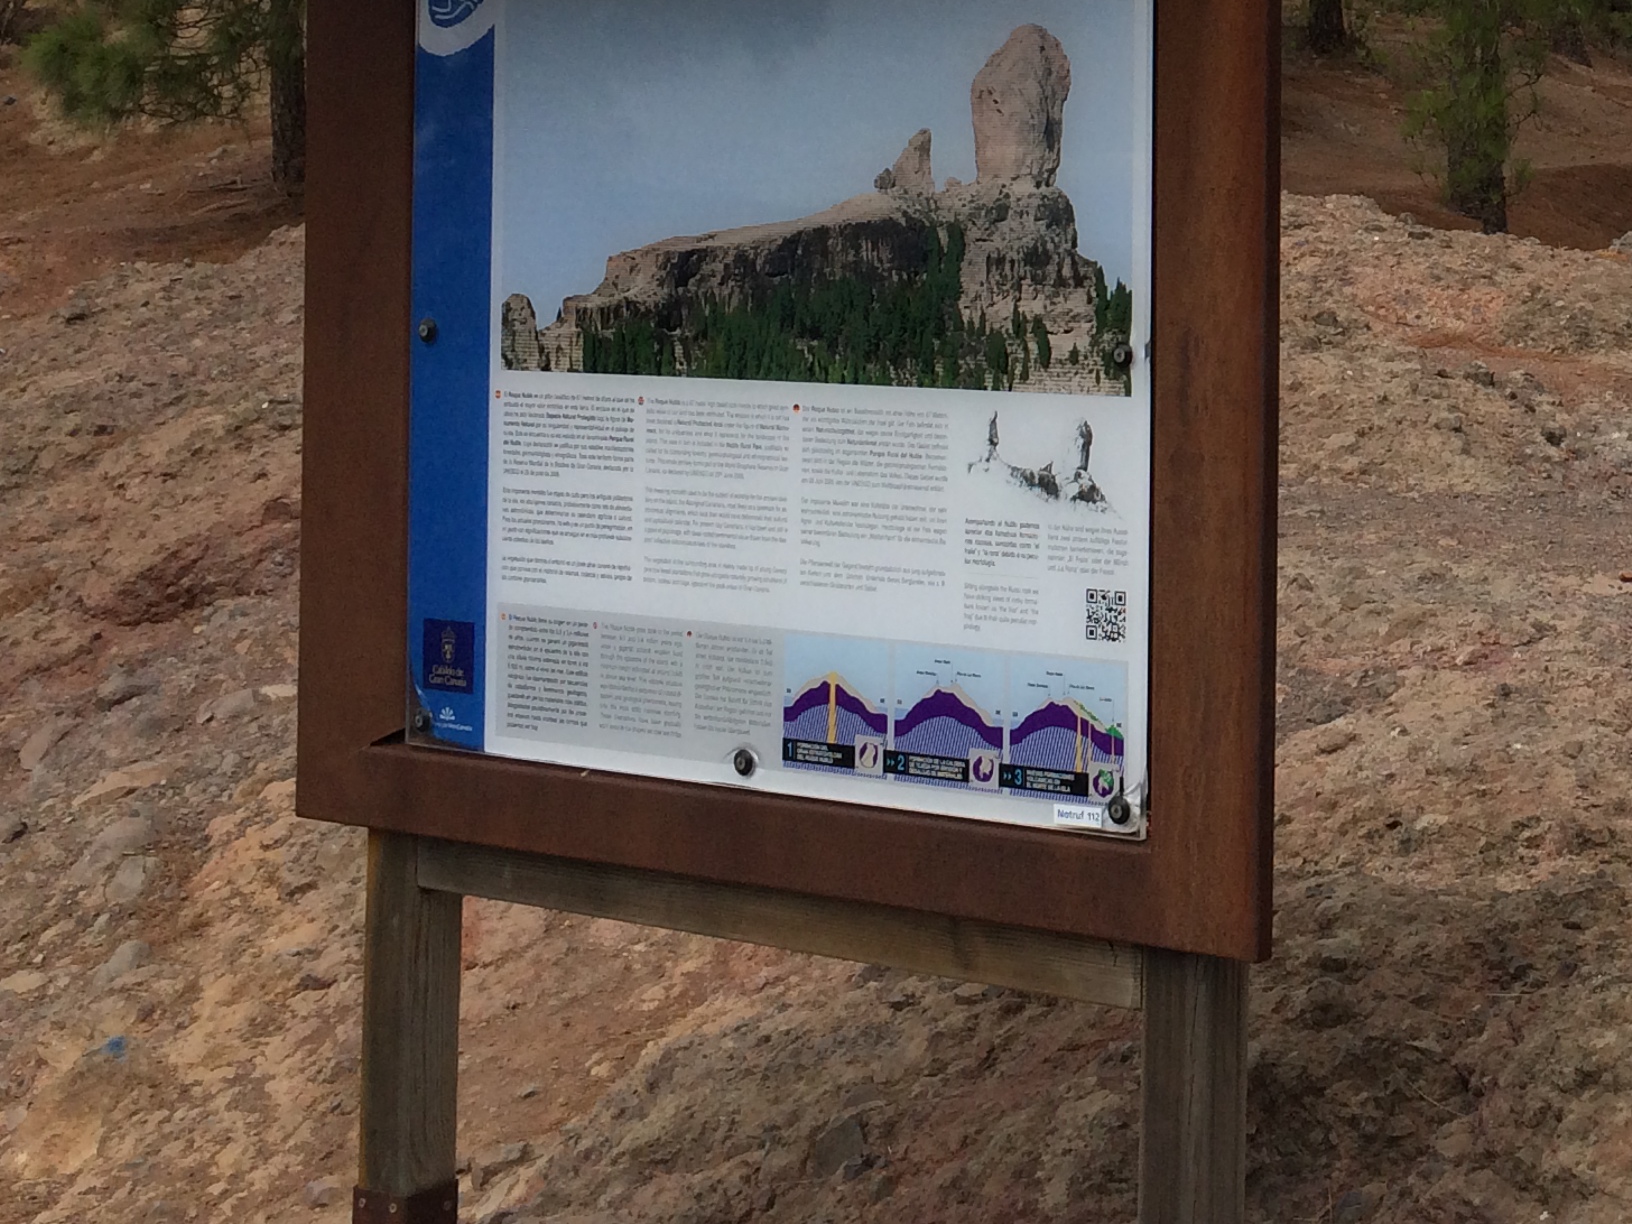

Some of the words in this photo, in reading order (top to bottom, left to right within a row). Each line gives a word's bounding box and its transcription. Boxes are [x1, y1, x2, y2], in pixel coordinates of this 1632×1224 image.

[787, 742, 793, 758] 1
[897, 755, 905, 771] 2
[1014, 768, 1023, 785] 3
[1057, 809, 1084, 819] Notruf
[1086, 810, 1101, 822] 112
